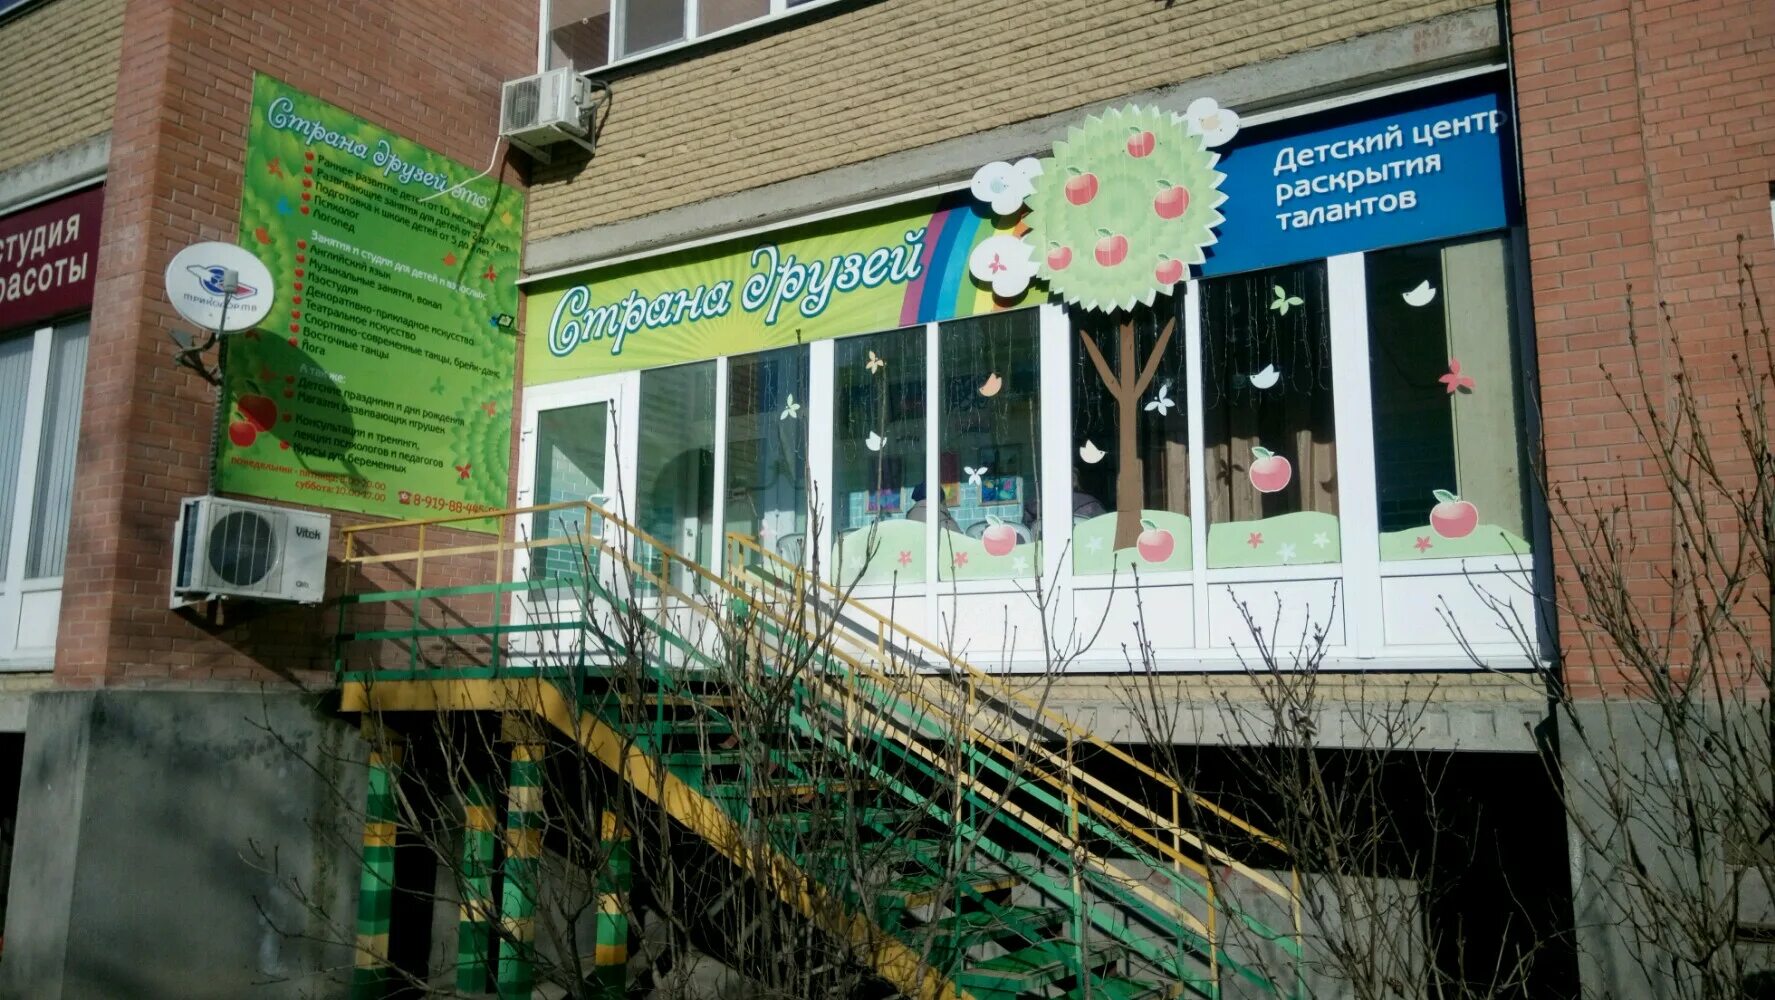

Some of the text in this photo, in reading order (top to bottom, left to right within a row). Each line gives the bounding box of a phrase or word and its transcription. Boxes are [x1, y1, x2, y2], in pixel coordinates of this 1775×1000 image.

[268, 97, 368, 160] Страна
[372, 139, 448, 191] друзей
[1273, 109, 1507, 176] Детский центр
[318, 154, 353, 176] Раннее
[355, 172, 399, 195] развитие
[428, 203, 438, 211] от
[439, 205, 450, 217] 10
[1275, 153, 1442, 207] раскрытия
[312, 208, 356, 234] Логопед
[314, 194, 360, 220] Психолог
[315, 181, 372, 211] Подготовка
[374, 206, 380, 215] к
[381, 209, 410, 227] школе
[411, 221, 438, 237] детей
[439, 232, 449, 241] от
[451, 235, 457, 245] 5
[457, 240, 469, 250] до
[317, 167, 382, 201] Развивающие
[385, 197, 418, 216] занятия
[420, 211, 434, 224] для
[435, 217, 460, 234] детей
[461, 228, 471, 238] от
[496, 242, 510, 253] лет
[1275, 190, 1418, 231] талантов
[310, 244, 391, 281] Английский язык
[311, 229, 352, 252] Занятия
[352, 246, 359, 256] и
[361, 250, 393, 268] студии
[394, 262, 411, 273] для
[411, 268, 438, 284] детей
[439, 278, 446, 286] и
[308, 271, 359, 296] Изостудия
[309, 257, 442, 311] Музыкальные занятия, вокал
[548, 227, 929, 357] Страна друзей
[304, 312, 423, 356] Спортивно-современные
[305, 298, 416, 341] Театральное искусство
[306, 285, 475, 346] Декоративно-прикладное искусство
[301, 338, 326, 356] Йога
[303, 326, 389, 360] Восточные танцы
[297, 377, 465, 427] Детские праздники и дни рождения
[297, 390, 445, 435] Магазин развивающих игрушек
[295, 413, 420, 450] Консультации и тренинги,
[334, 438, 389, 457] психологов
[391, 450, 397, 458] и
[398, 451, 444, 468] педагогов
[231, 456, 293, 474] понедельник
[347, 453, 406, 474] беременных
